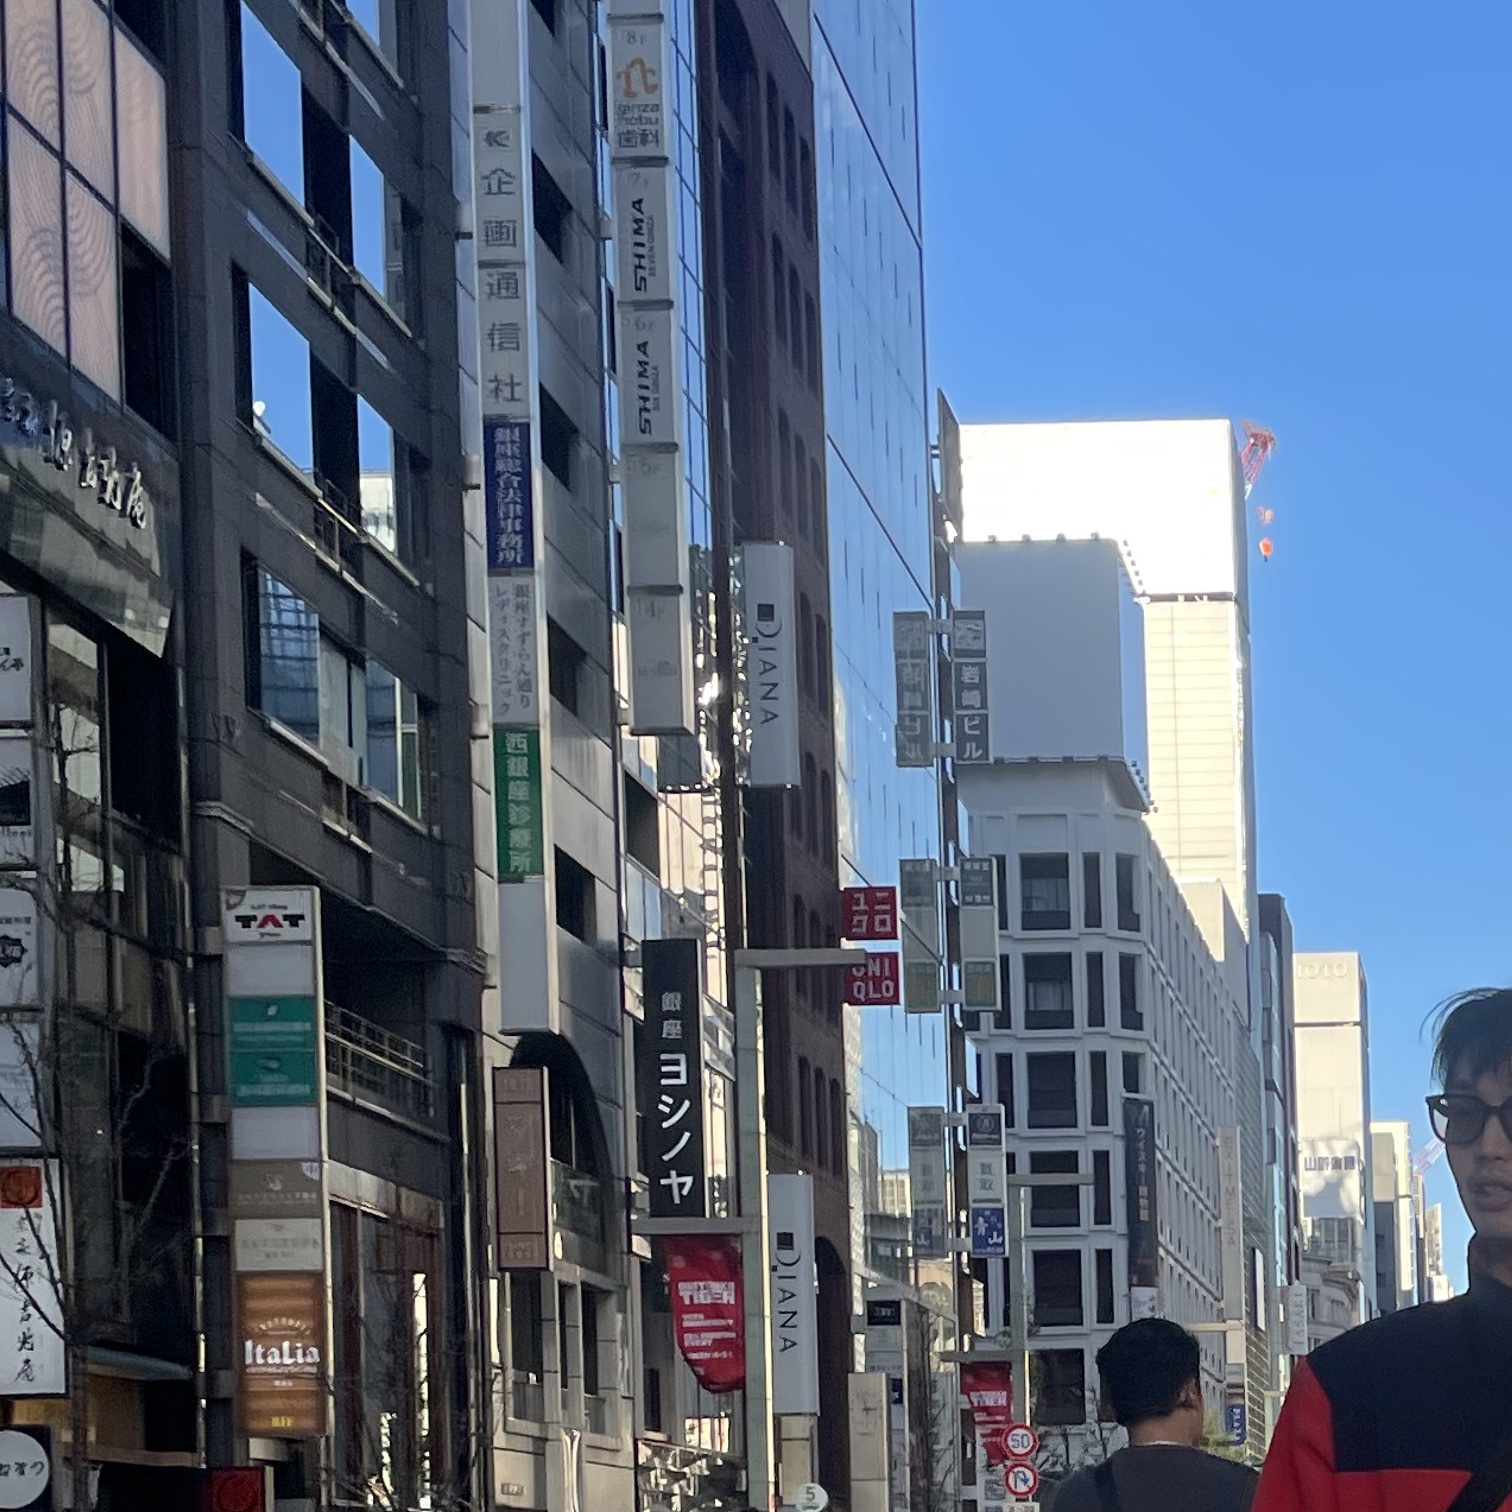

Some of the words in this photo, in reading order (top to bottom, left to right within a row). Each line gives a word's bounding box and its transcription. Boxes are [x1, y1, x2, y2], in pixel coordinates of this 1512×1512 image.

[631, 197, 647, 293] SHIMA
[636, 340, 652, 436] SHIMA
[756, 606, 783, 725] DIANA
[505, 732, 532, 873] 西銀座診療所
[234, 913, 306, 929] TAT
[853, 979, 895, 1002] QLO
[775, 1236, 801, 1353] DIANA
[1010, 1433, 1031, 1449] 50
[805, 1486, 816, 1501] 5
